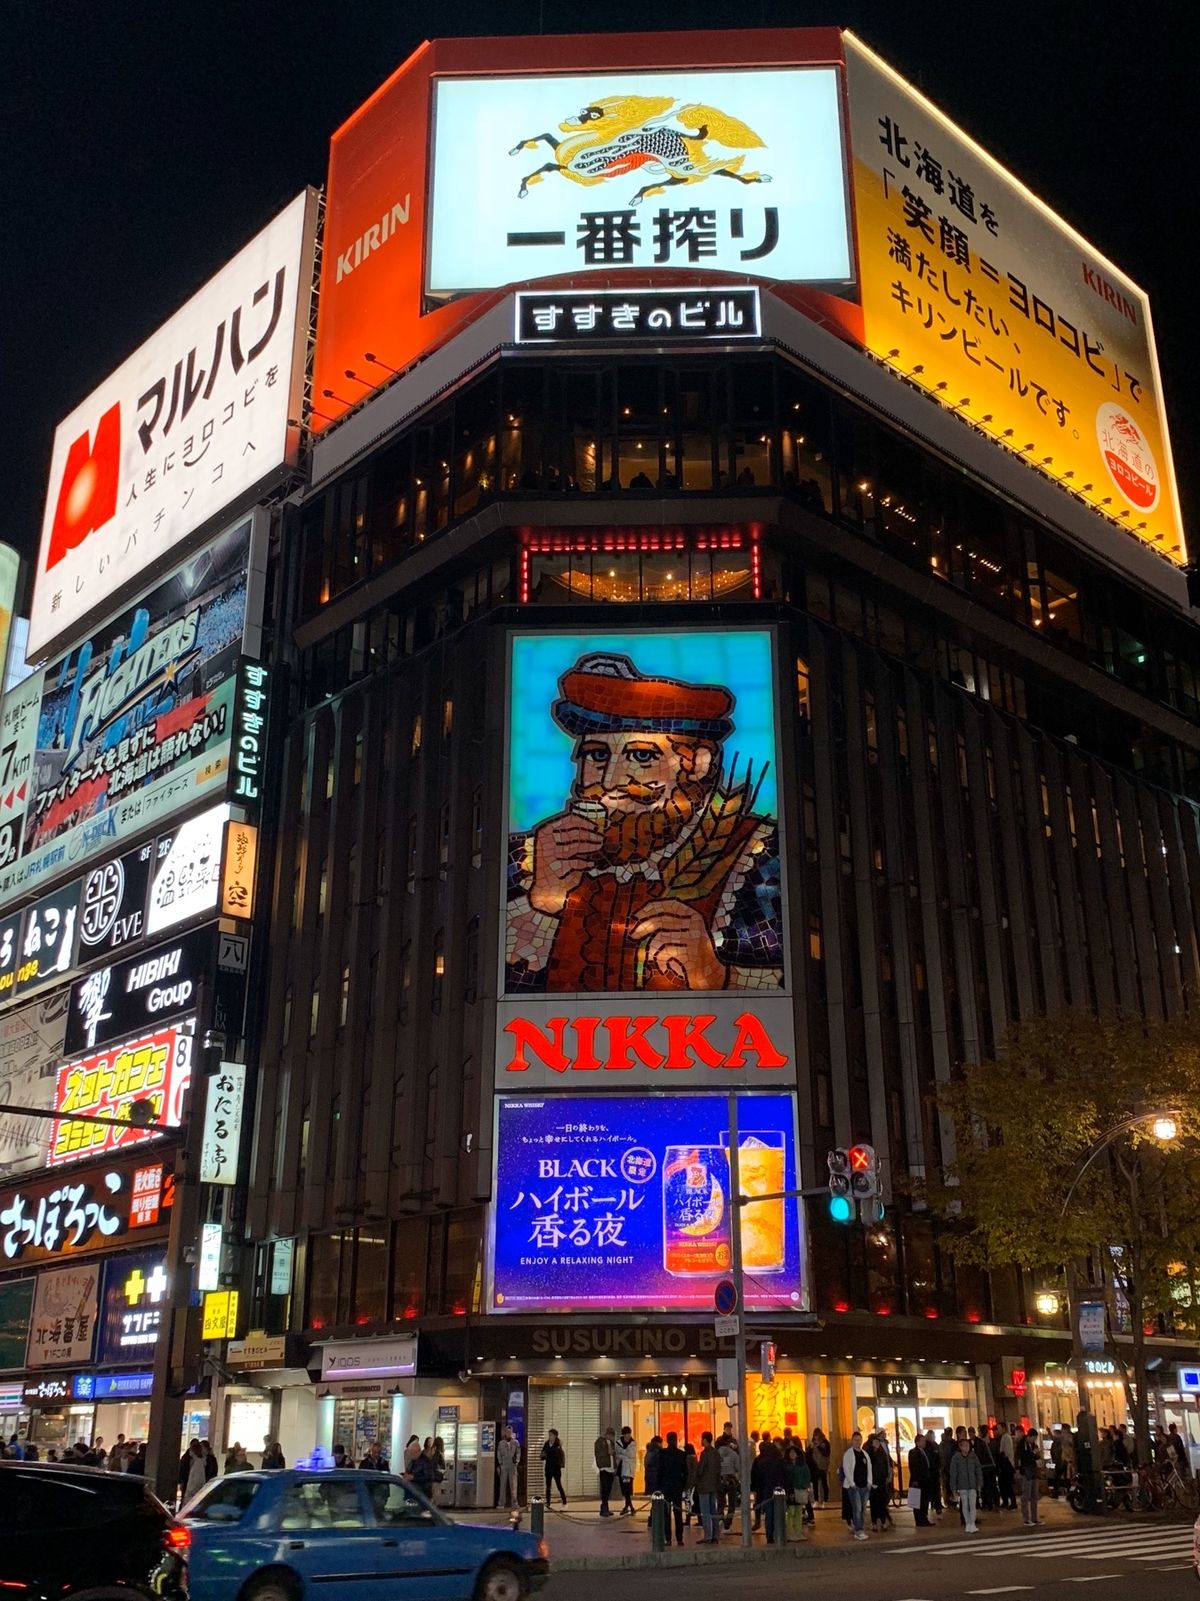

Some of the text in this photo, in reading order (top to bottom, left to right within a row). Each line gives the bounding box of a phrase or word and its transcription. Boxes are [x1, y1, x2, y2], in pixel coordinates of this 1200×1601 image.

[878, 116, 999, 237] 北海道を
[336, 194, 411, 285] KIRIN
[507, 206, 780, 265] 一番搾り
[886, 226, 1021, 354] 満たしたい、
[1083, 262, 1137, 327] KIRIN
[533, 300, 744, 333] すすきのビル
[136, 264, 286, 455] マルハン
[890, 281, 1080, 441] キリンビールです。
[125, 366, 278, 507] 人生にヨロコビを
[1102, 428, 1155, 481] 北海道の
[1110, 458, 1153, 497] ヨロコビール
[51, 442, 256, 614] 新しいパチンコへ
[62, 606, 200, 776] FIGHTERS
[236, 664, 267, 798] すすきのビル
[36, 724, 157, 815] ファイターズを見ずに
[145, 778, 190, 810] ファイターズ
[121, 803, 141, 824] または
[140, 845, 152, 861] 8F
[157, 838, 172, 858] 2F
[111, 911, 144, 947] EVE
[127, 949, 182, 993] HIBIKI
[148, 980, 192, 1013] Group
[503, 1011, 788, 1073] NIKKA
[61, 1046, 168, 1114] ネットカフェ
[521, 1134, 638, 1145] ちょっと幸せにしてくれるハイボール。
[556, 1123, 610, 1133] 一日の終わりを、
[538, 1158, 618, 1179] BLACK
[627, 1154, 653, 1168] 北海道
[628, 1165, 648, 1177] 限定
[509, 1184, 645, 1213] ハイボール
[528, 1213, 629, 1248] 香る夜
[520, 1256, 634, 1265] ENJOY A RELAXING NIGHT
[532, 1328, 687, 1352] SUSUKINO
[1085, 1361, 1115, 1374] きのビル
[782, 1380, 799, 1411] 札幌
